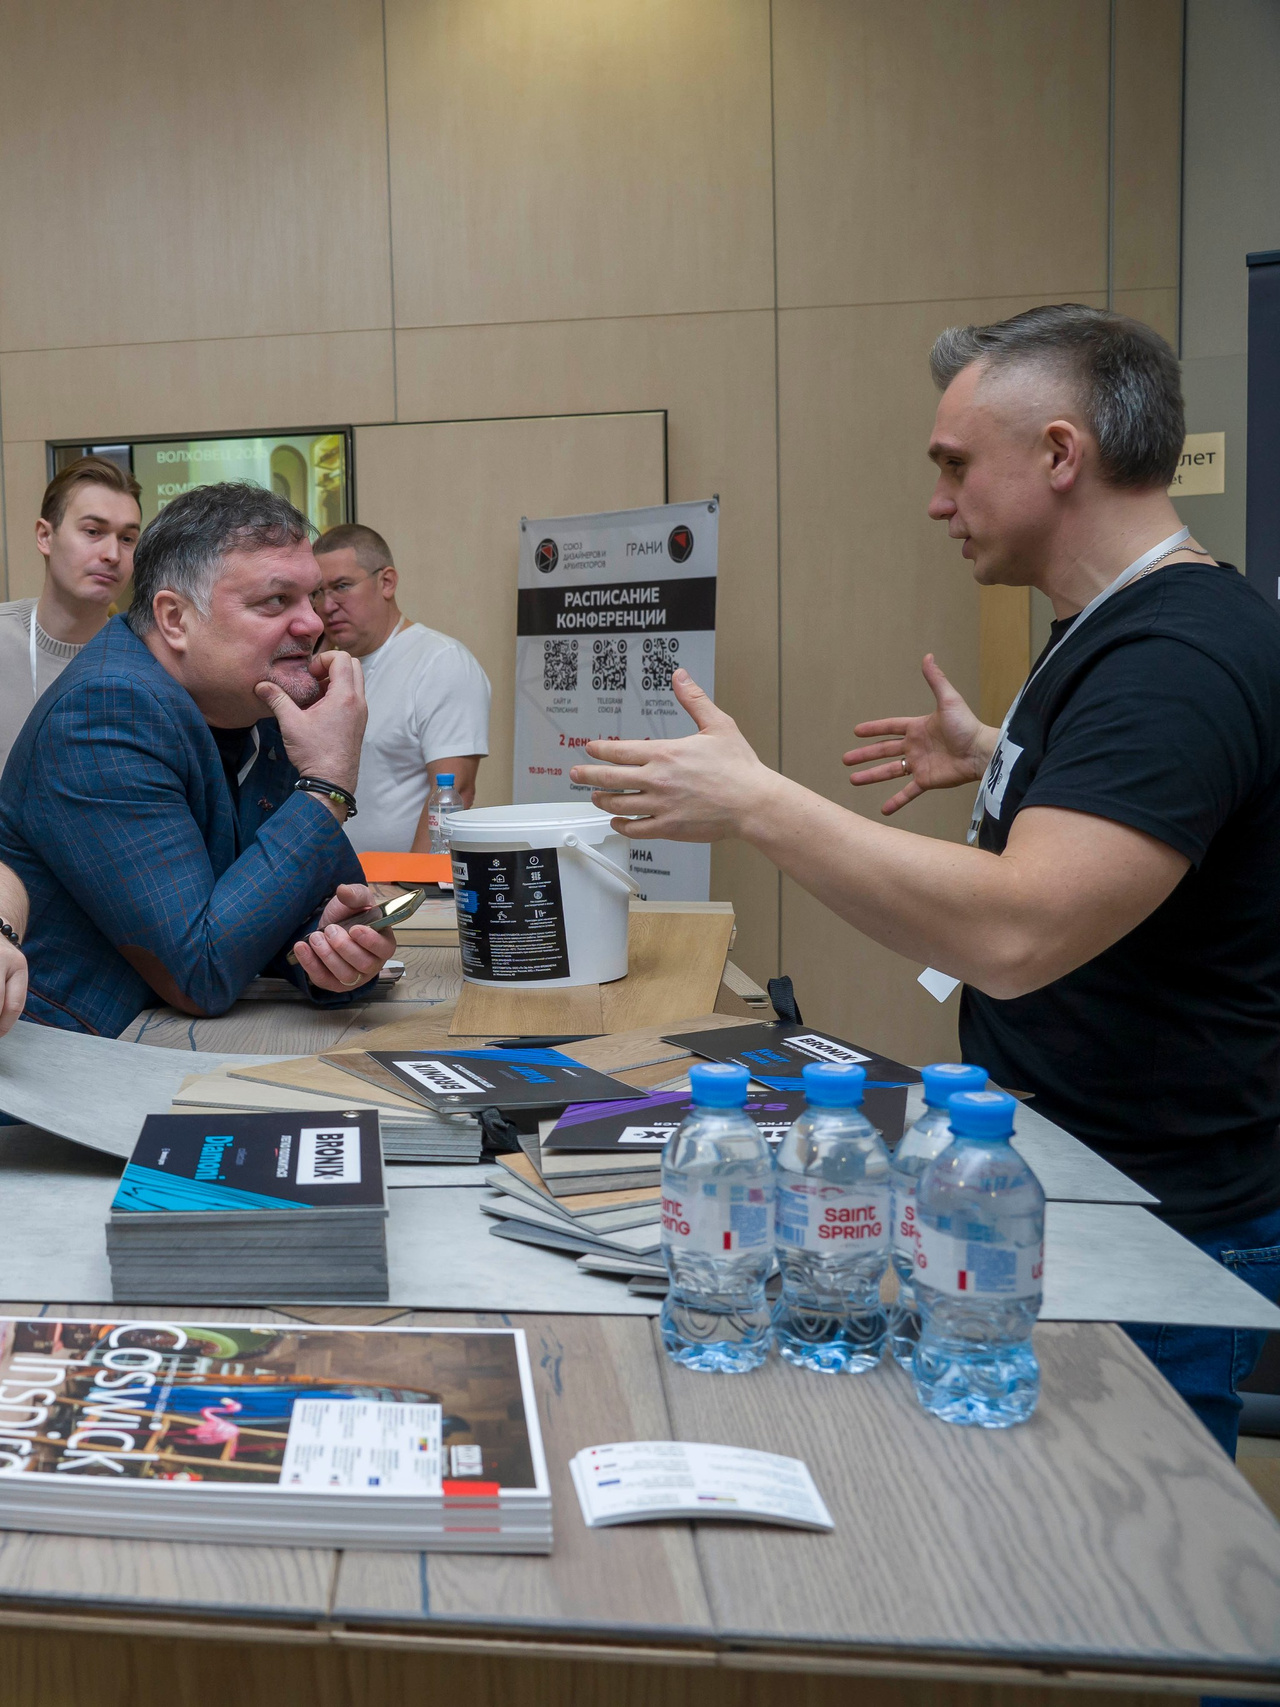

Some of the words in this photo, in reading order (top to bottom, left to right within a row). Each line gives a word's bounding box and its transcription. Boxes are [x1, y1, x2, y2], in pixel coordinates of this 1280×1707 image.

[157, 449, 232, 464] ВОЛХОВЕЦ
[1177, 452, 1216, 467] лет
[563, 542, 583, 551] СОЮЗ
[626, 541, 663, 557] ГРАНИ
[564, 587, 660, 607] РАСПИСАНИЕ
[556, 609, 666, 628] КОНФЕРЕНЦИИ
[559, 733, 566, 746] 2
[528, 766, 563, 776] 10:30-11:20
[800, 1037, 856, 1061] BRONIX
[408, 1062, 467, 1090] BRONIX
[194, 1135, 234, 1181] Diamoni
[313, 1133, 344, 1178] BRONIX
[818, 1221, 882, 1239] SPRING
[57, 1323, 187, 1473] Coswick
